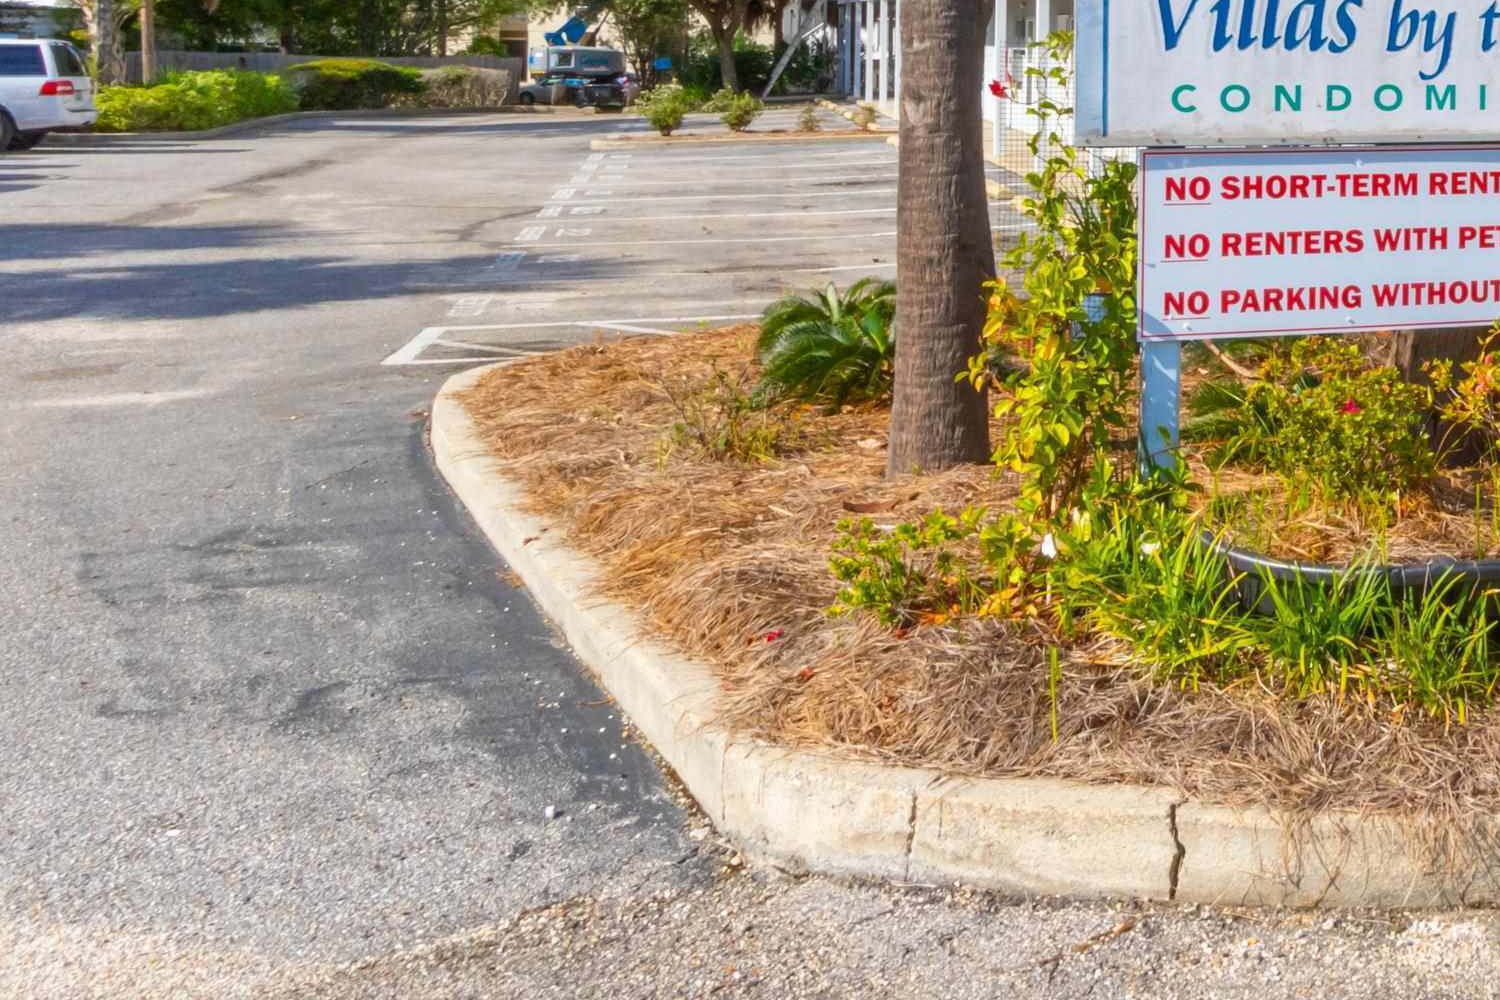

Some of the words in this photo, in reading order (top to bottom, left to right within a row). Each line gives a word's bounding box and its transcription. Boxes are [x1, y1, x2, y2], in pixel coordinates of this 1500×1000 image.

[1165, 176, 1211, 201] NO
[1221, 172, 1418, 200] SHORT-TERM
[1164, 233, 1210, 259] NO
[1221, 229, 1364, 257] RENTERS
[1374, 227, 1448, 252] WITH
[1164, 291, 1210, 316] NO
[1221, 285, 1362, 313] PARKING
